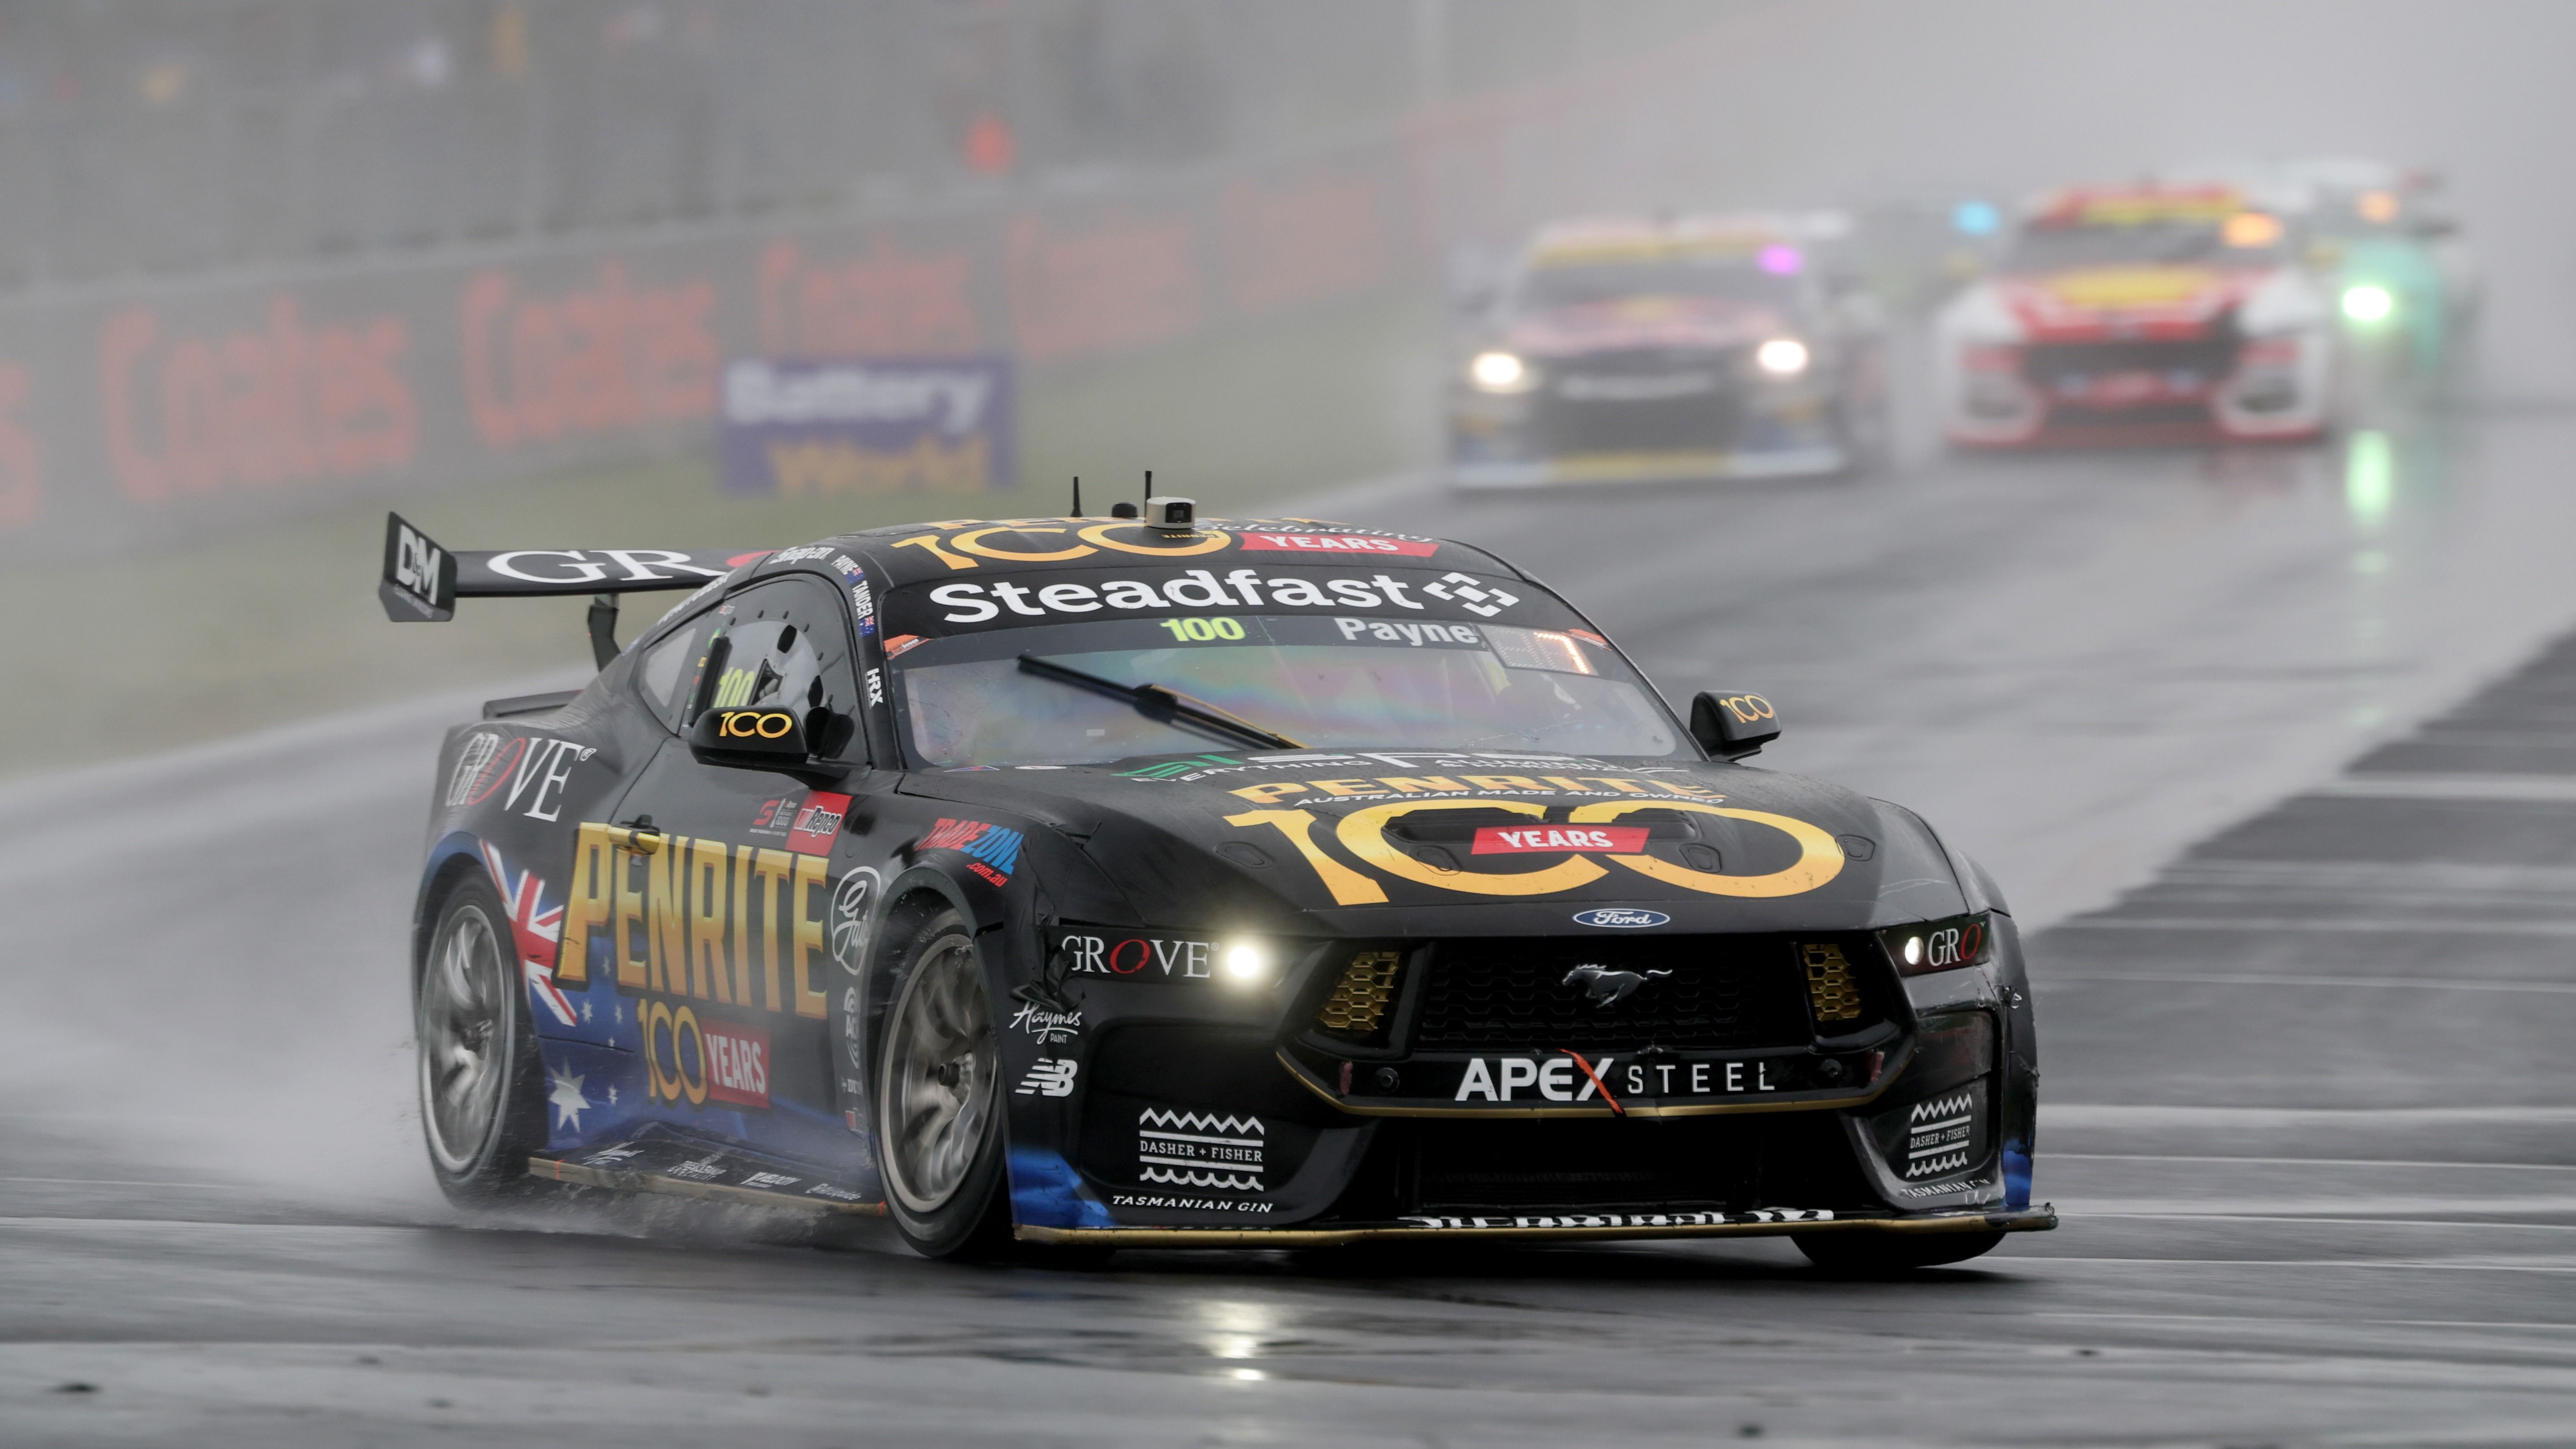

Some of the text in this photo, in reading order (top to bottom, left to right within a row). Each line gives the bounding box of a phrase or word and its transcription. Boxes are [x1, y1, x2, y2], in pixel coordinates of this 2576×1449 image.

[100, 293, 416, 504] Coates
[726, 359, 992, 433] Battery
[767, 436, 991, 495] World
[1260, 536, 1399, 551] YEARS
[831, 555, 861, 575] PAYNE
[852, 580, 874, 619] TANDER
[929, 570, 1421, 623] Steadfast
[1160, 618, 1245, 642] 100
[1334, 618, 1478, 646] Payne
[867, 668, 883, 707] HRX
[446, 732, 590, 822] GROVE
[1435, 759, 1626, 770] ALUMINIU
[1228, 776, 1728, 803] PENRITE
[1294, 791, 1469, 806] AUSTRALIAN
[1630, 793, 1724, 803] OWNED
[804, 806, 841, 837] Repco
[1498, 830, 1614, 848] YEARS
[555, 822, 829, 1020] PENRITE
[1593, 909, 1651, 925] Ford
[1061, 935, 1211, 978] GROVE
[1927, 922, 1985, 967] GRO
[1009, 1001, 1082, 1045] Haymes
[637, 999, 706, 1104] 100
[1050, 1034, 1067, 1044] PAINT
[705, 1033, 766, 1095] YEARS
[1455, 1048, 1775, 1114] APEX STEEL
[1140, 1140, 1195, 1157] DASHER
[1211, 1147, 1263, 1162] FISHER
[1910, 1133, 1939, 1149] DASHER
[1946, 1126, 1970, 1141] FISHER
[1113, 1195, 1274, 1213] TASMANIAN GIN
[1901, 1182, 1973, 1198] TASMANIAN
